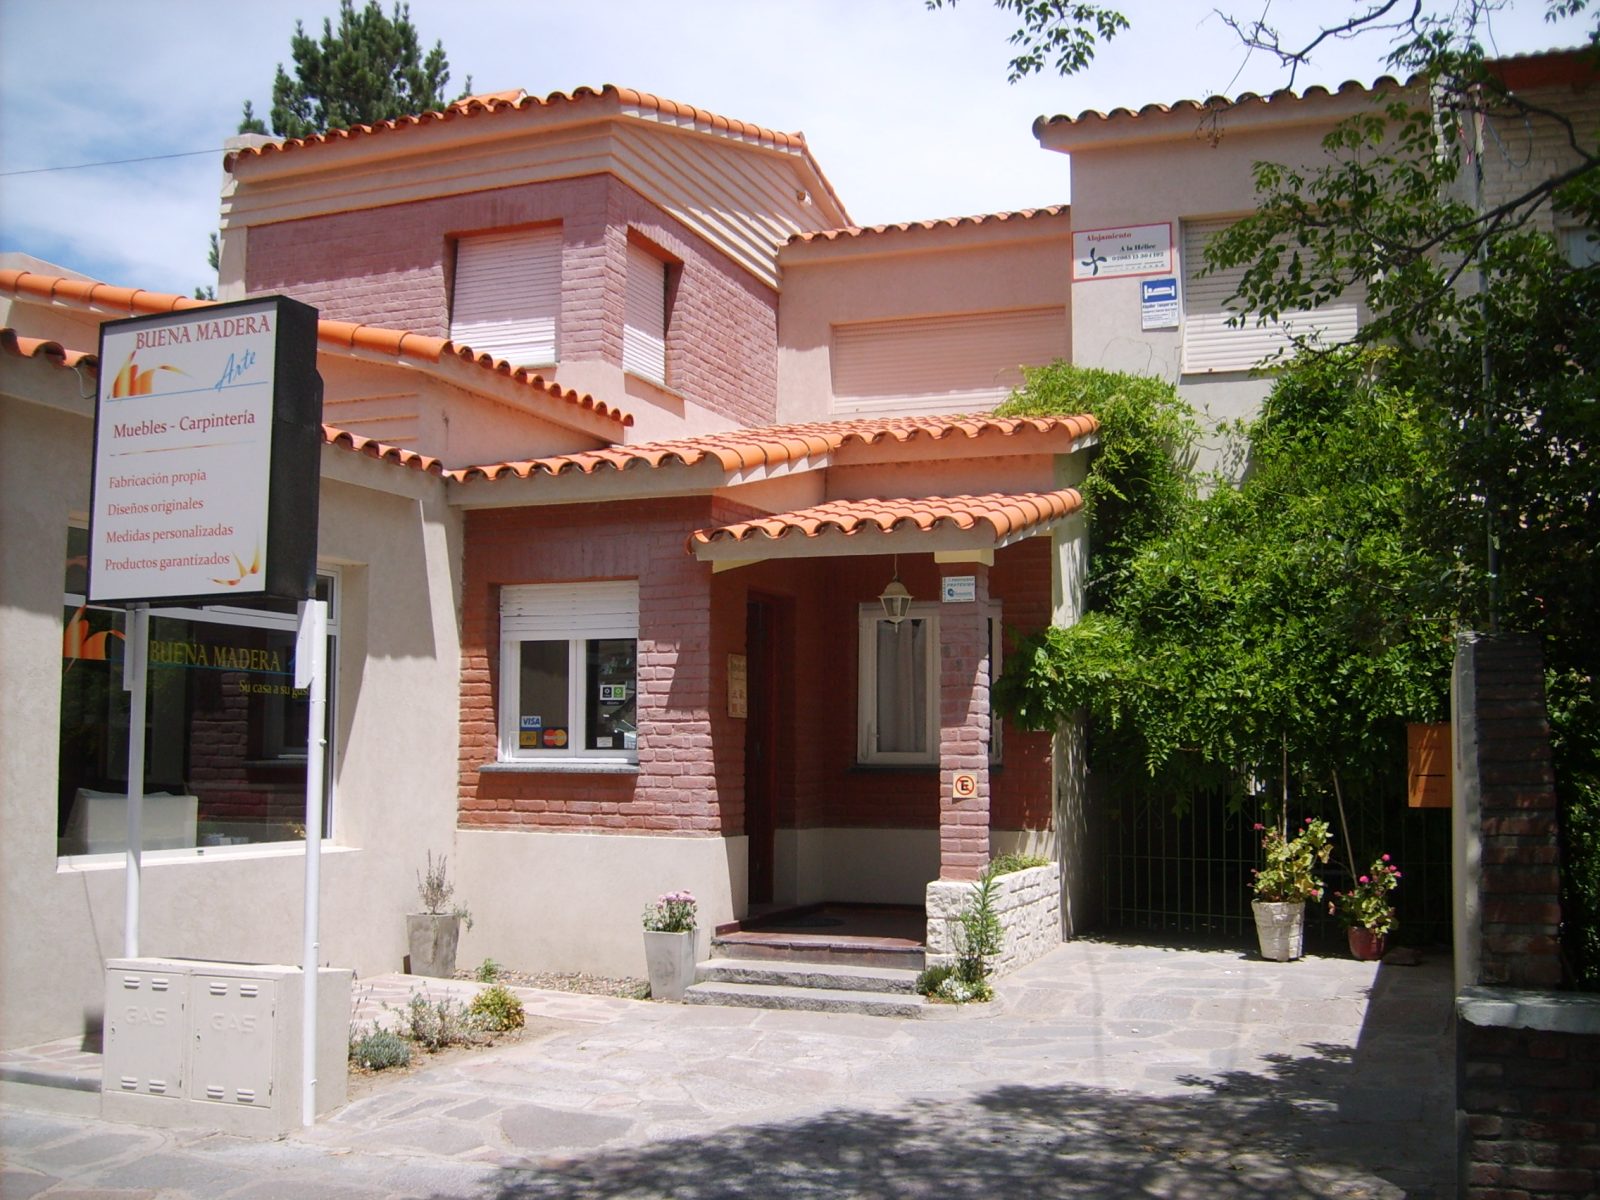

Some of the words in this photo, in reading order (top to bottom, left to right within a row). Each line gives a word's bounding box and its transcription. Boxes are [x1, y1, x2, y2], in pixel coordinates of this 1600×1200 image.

[1087, 232, 1132, 242] Alojamiento
[136, 327, 191, 349] BUENA
[196, 315, 271, 341] MADERA
[214, 348, 256, 392] Arte
[113, 420, 167, 438] Muebles
[179, 410, 256, 433] Carpintería
[109, 472, 169, 489] Fabricación
[171, 469, 207, 487] propia
[107, 502, 149, 516] Diseños
[151, 497, 204, 515] originales
[106, 529, 151, 543] Medidas
[152, 523, 234, 543] personalizadas
[105, 557, 158, 571] Productos
[159, 552, 231, 571] garantizados
[151, 641, 208, 666] BUENA
[214, 646, 281, 671] MADERA
[240, 679, 251, 693] Su
[252, 683, 272, 693] casa
[273, 684, 279, 694] a
[280, 685, 290, 696] su
[960, 779, 969, 791] E
[124, 1005, 168, 1027] GAS
[211, 1012, 256, 1034] GAS
